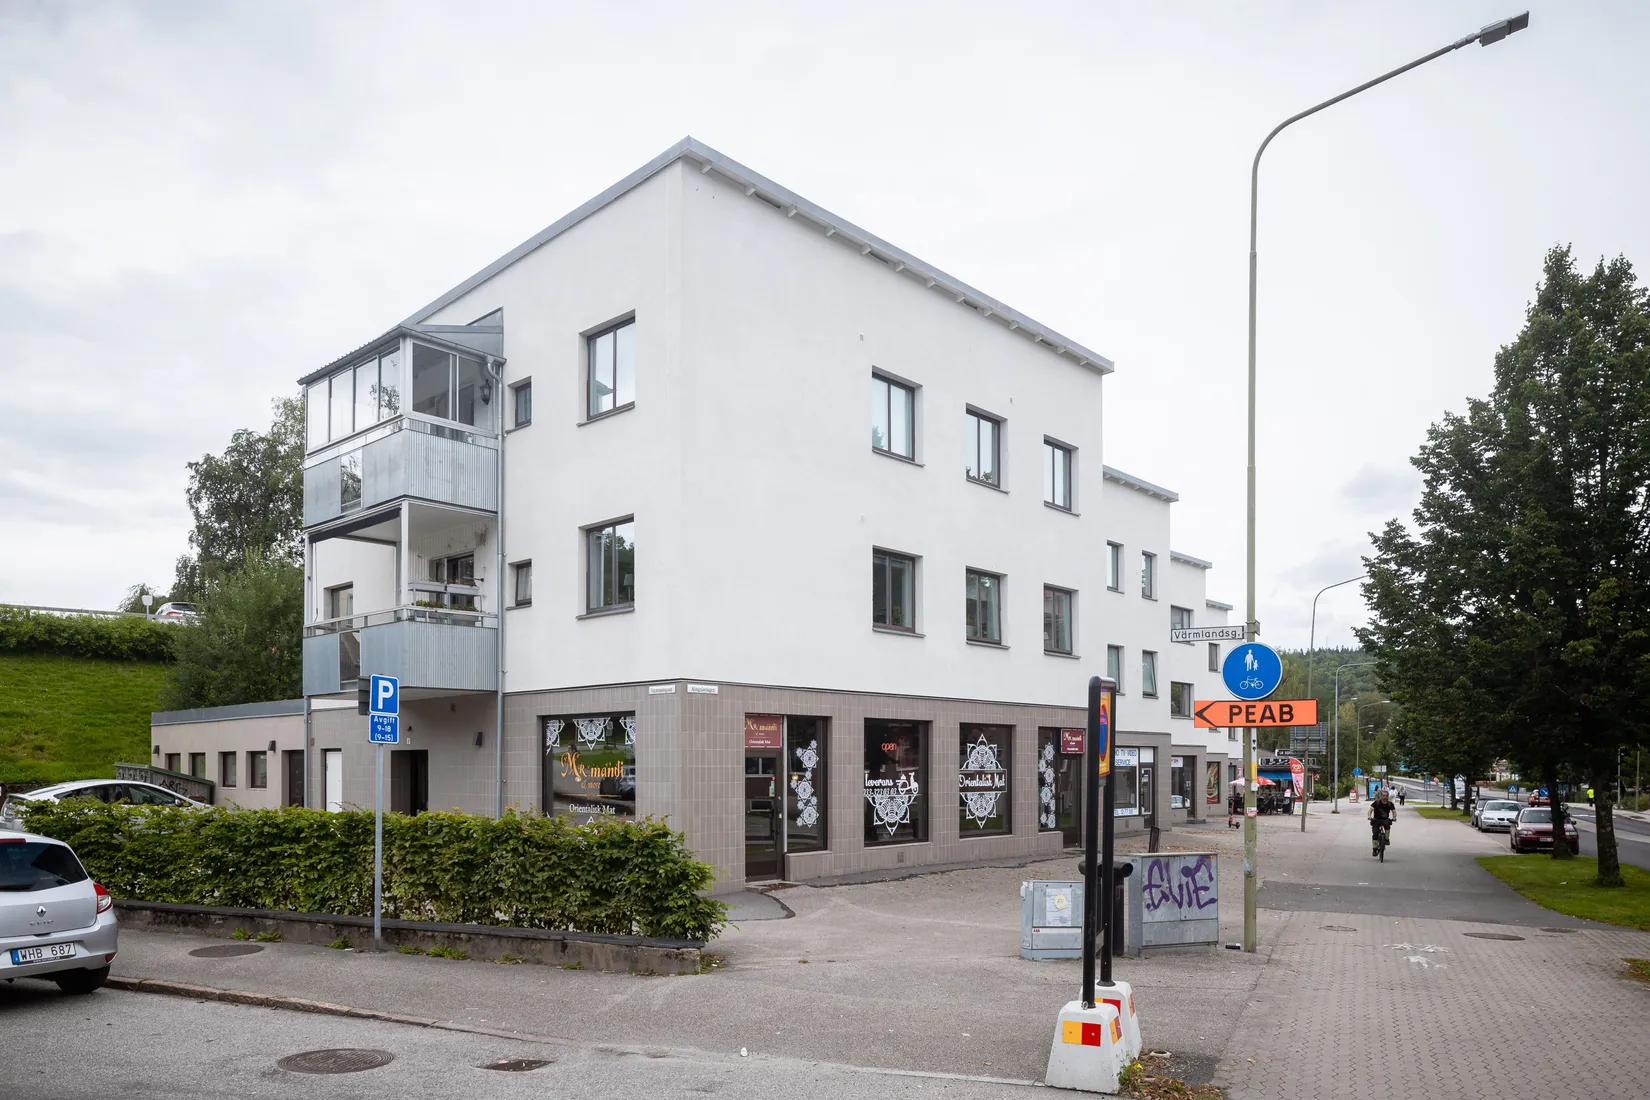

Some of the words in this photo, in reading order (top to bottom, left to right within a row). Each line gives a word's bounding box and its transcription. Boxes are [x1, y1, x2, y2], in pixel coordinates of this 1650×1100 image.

[1174, 629, 1240, 640] Värmlandsg.
[377, 679, 395, 710] P
[1229, 703, 1294, 724] PEAB
[373, 715, 395, 724] Avgift
[377, 724, 392, 732] 9-18
[374, 733, 394, 741] (9-15)
[881, 743, 897, 752] open
[959, 774, 993, 788] Orientalisk
[992, 772, 1005, 789] Mat
[568, 803, 601, 814] Orientalisk
[602, 804, 616, 815] Mat
[20, 947, 43, 961] WHB
[50, 943, 72, 956] 687
